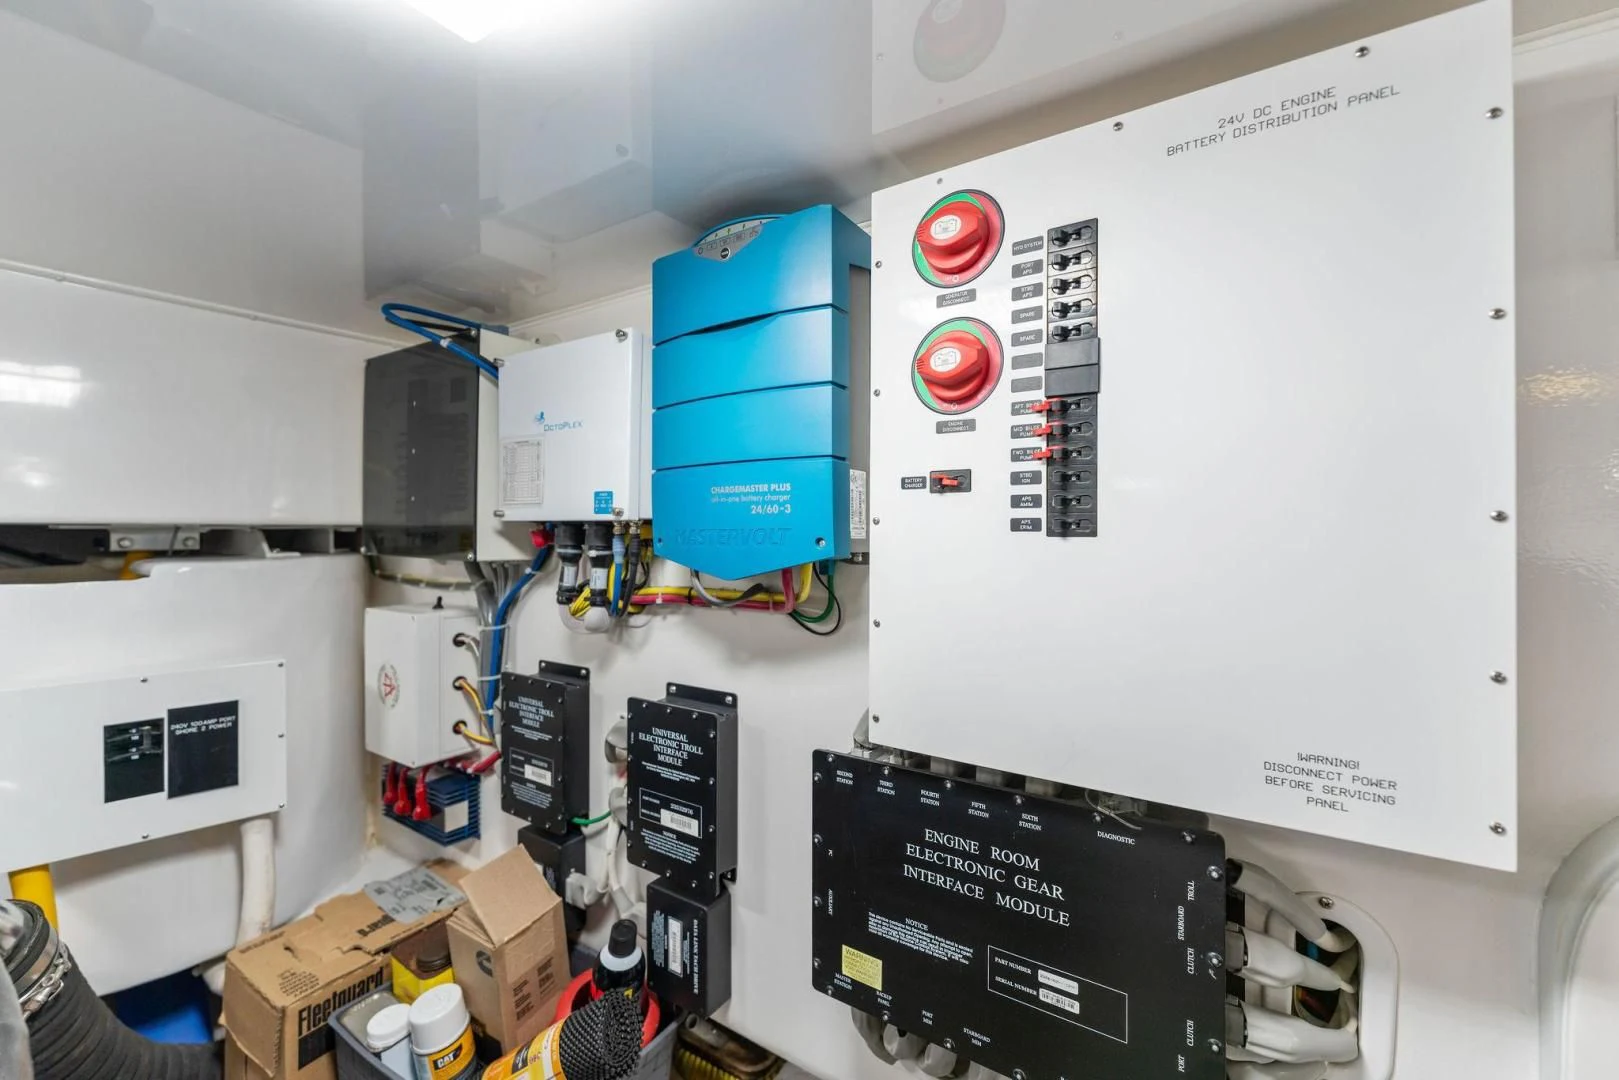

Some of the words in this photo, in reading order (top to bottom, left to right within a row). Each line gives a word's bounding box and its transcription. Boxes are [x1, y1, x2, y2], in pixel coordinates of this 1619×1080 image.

[1217, 112, 1246, 129] 24V
[1253, 104, 1273, 120] DC
[1280, 86, 1337, 111] ENGINE
[1166, 131, 1227, 156] BATTERY
[1232, 101, 1338, 139] DISTRIBUTION
[1347, 84, 1401, 108] PANEL
[710, 484, 769, 495] CHARGEMASTER
[770, 483, 791, 492] PLUS
[764, 493, 791, 503] charger
[751, 503, 792, 514] 24/60-3
[508, 700, 538, 713] ELECTRONIC
[538, 708, 555, 718] TROLL
[218, 715, 236, 723] PORT
[175, 727, 199, 736] SHORE
[208, 721, 233, 731] POWER
[652, 727, 689, 743] UNIVERSAL
[638, 732, 680, 749] ELECTRONIC
[680, 742, 704, 755] TROLL
[653, 744, 689, 760] INTERFACE
[657, 753, 683, 767] MODULE
[1297, 752, 1360, 770] !WARNING!
[1263, 761, 1343, 782] DISCONNECT
[1352, 775, 1398, 791] POWER
[877, 786, 896, 796] STATION
[920, 789, 940, 799] FOURTH
[1265, 775, 1314, 792] BEFORE
[1322, 784, 1397, 806] SERVICING
[920, 797, 940, 807] STATION
[971, 801, 986, 810] FIFTH
[1306, 796, 1349, 813] PANEL
[968, 808, 990, 819] STATION
[1021, 812, 1039, 823] SIXTH
[1018, 820, 1042, 831] STATION
[1096, 830, 1136, 845] DIAGNOSTIC
[924, 828, 980, 855] ENGINE
[990, 845, 1041, 872] ROOM
[905, 842, 1006, 883] ELECTRONIC
[1014, 874, 1065, 901] GEAR
[903, 863, 985, 900] INTERFACE
[995, 891, 1071, 928] MODULE
[1187, 880, 1195, 901] TROLL
[905, 917, 929, 931] NOTICE
[1177, 905, 1185, 941] STARBOARD
[994, 956, 1008, 966] PART
[1008, 962, 1032, 975] NUMBER
[1187, 947, 1195, 975] CLUTCH
[995, 975, 1015, 987] SERIAL
[1014, 983, 1038, 996] NUMBER
[963, 1027, 991, 1043] STARBOARD
[1186, 1019, 1194, 1047] CLUTCH
[437, 1050, 457, 1068] CAT
[1177, 1053, 1185, 1073] PORT
